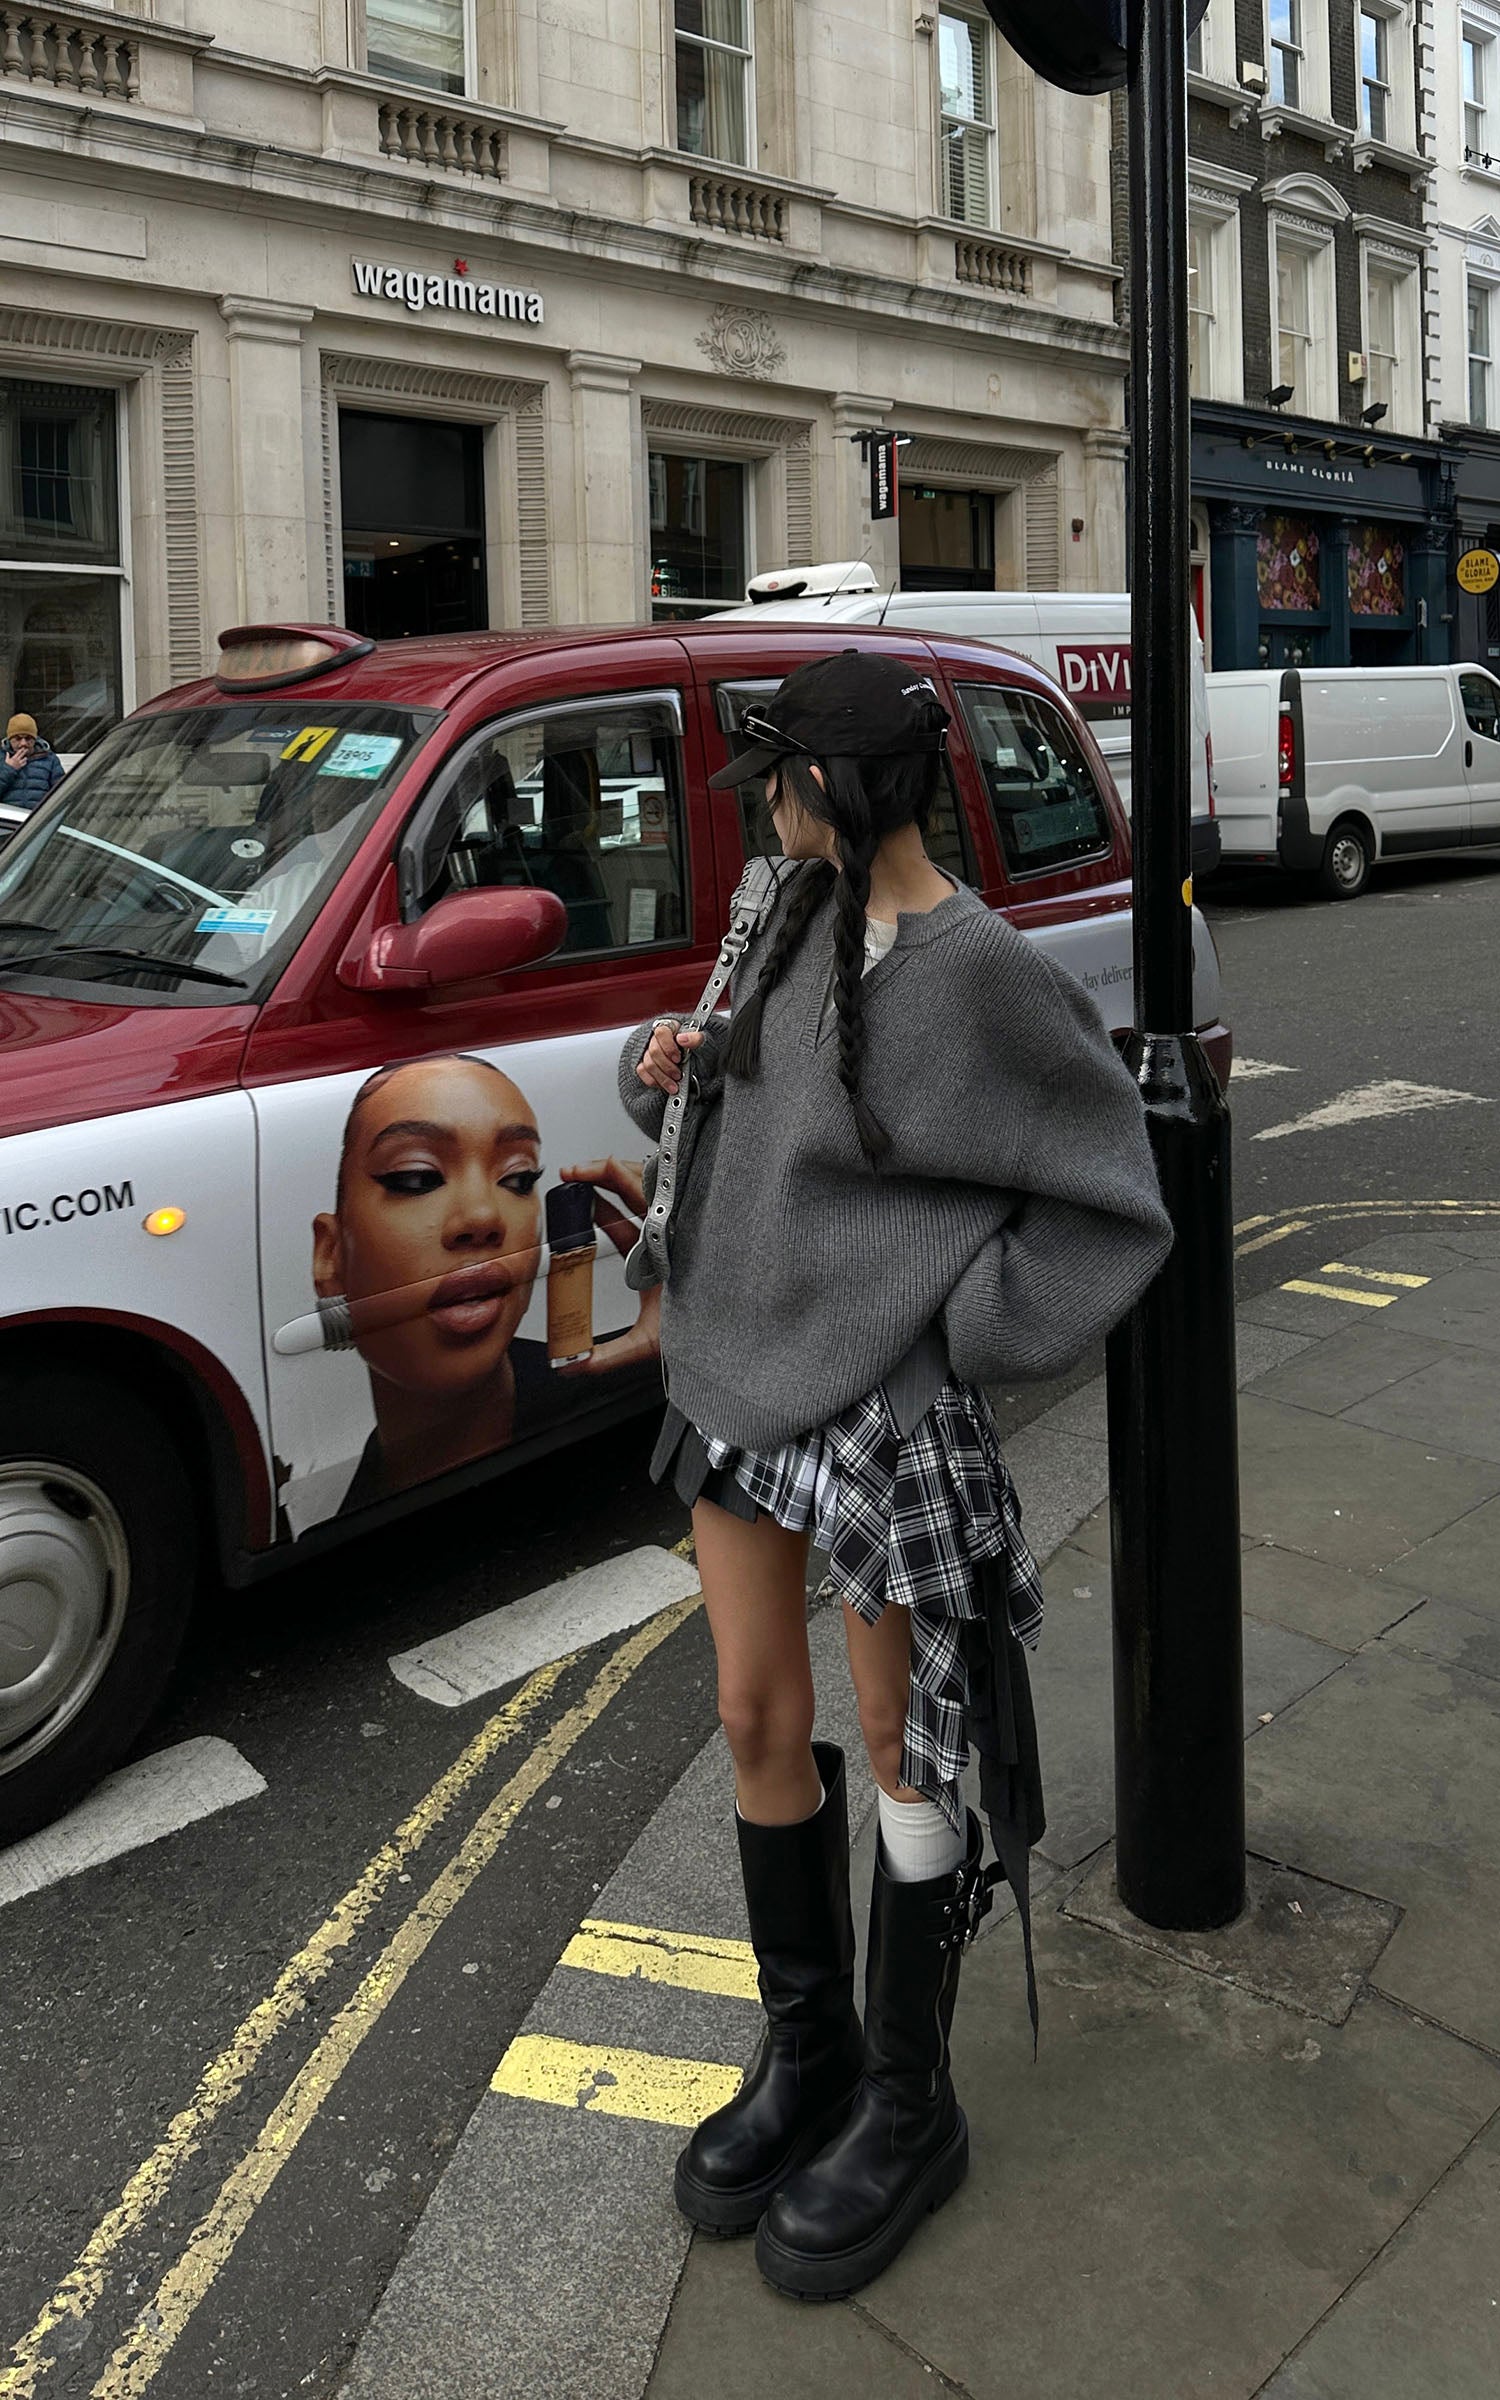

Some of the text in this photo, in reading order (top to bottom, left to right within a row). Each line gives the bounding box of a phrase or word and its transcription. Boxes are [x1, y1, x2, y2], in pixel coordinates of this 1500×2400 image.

[353, 262, 545, 324] wagamama
[878, 444, 889, 511] wagamama
[1266, 461, 1354, 484] BLAME GLORIA
[1464, 567, 1491, 578] GLORIA
[1465, 558, 1489, 568] BLAME
[0, 1180, 135, 1235] IC.COM
